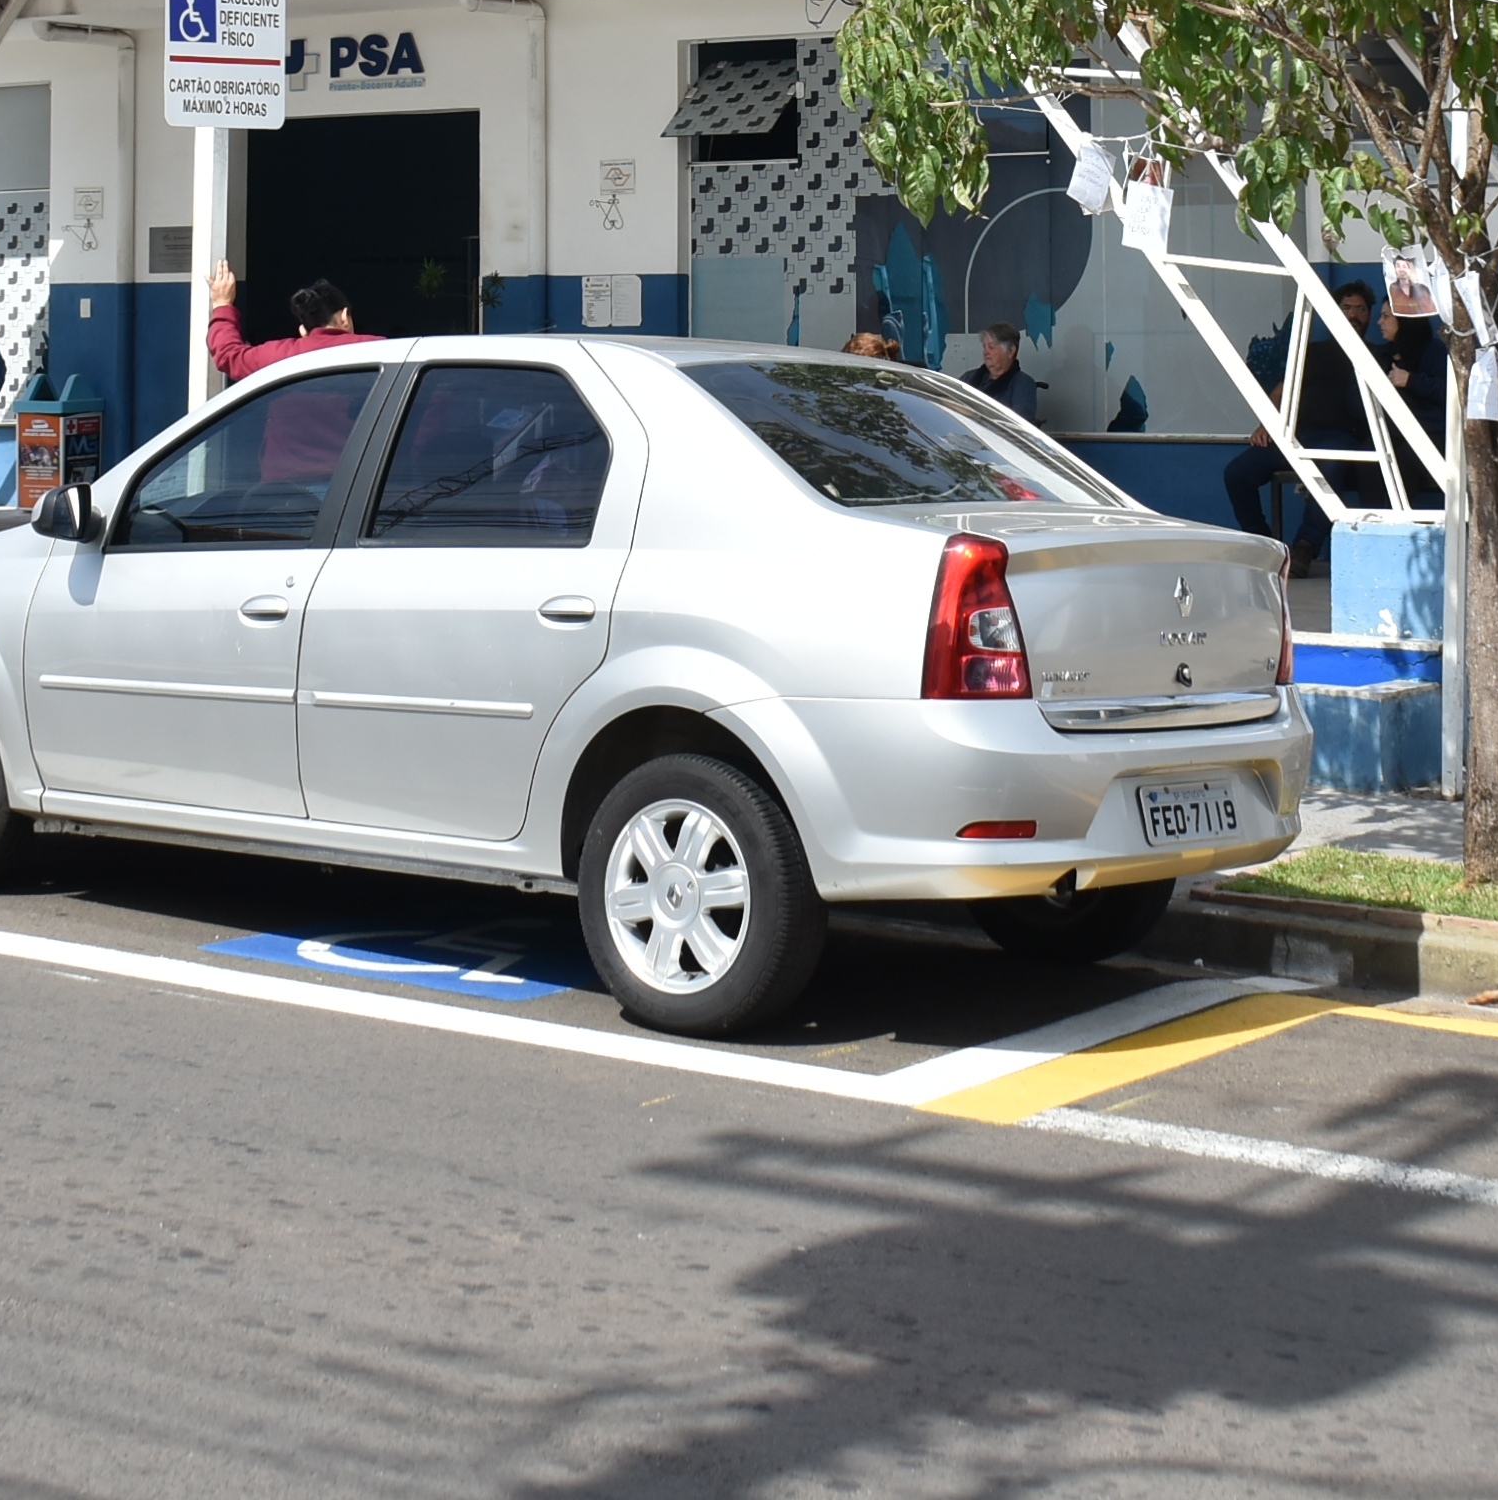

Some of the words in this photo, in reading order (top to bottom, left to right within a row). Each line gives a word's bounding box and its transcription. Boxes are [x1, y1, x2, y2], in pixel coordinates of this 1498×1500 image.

[219, 10, 280, 28] DEFICIENTE
[221, 28, 255, 48] FÍSICO
[330, 32, 425, 78] PSA
[169, 77, 211, 94] CARTÃO
[213, 78, 280, 97] OBRIGATÓRIO
[182, 96, 223, 114] MÁXIMO
[225, 100, 231, 114] 2
[233, 101, 268, 117] HORAS
[1160, 630, 1207, 646] LOGAN
